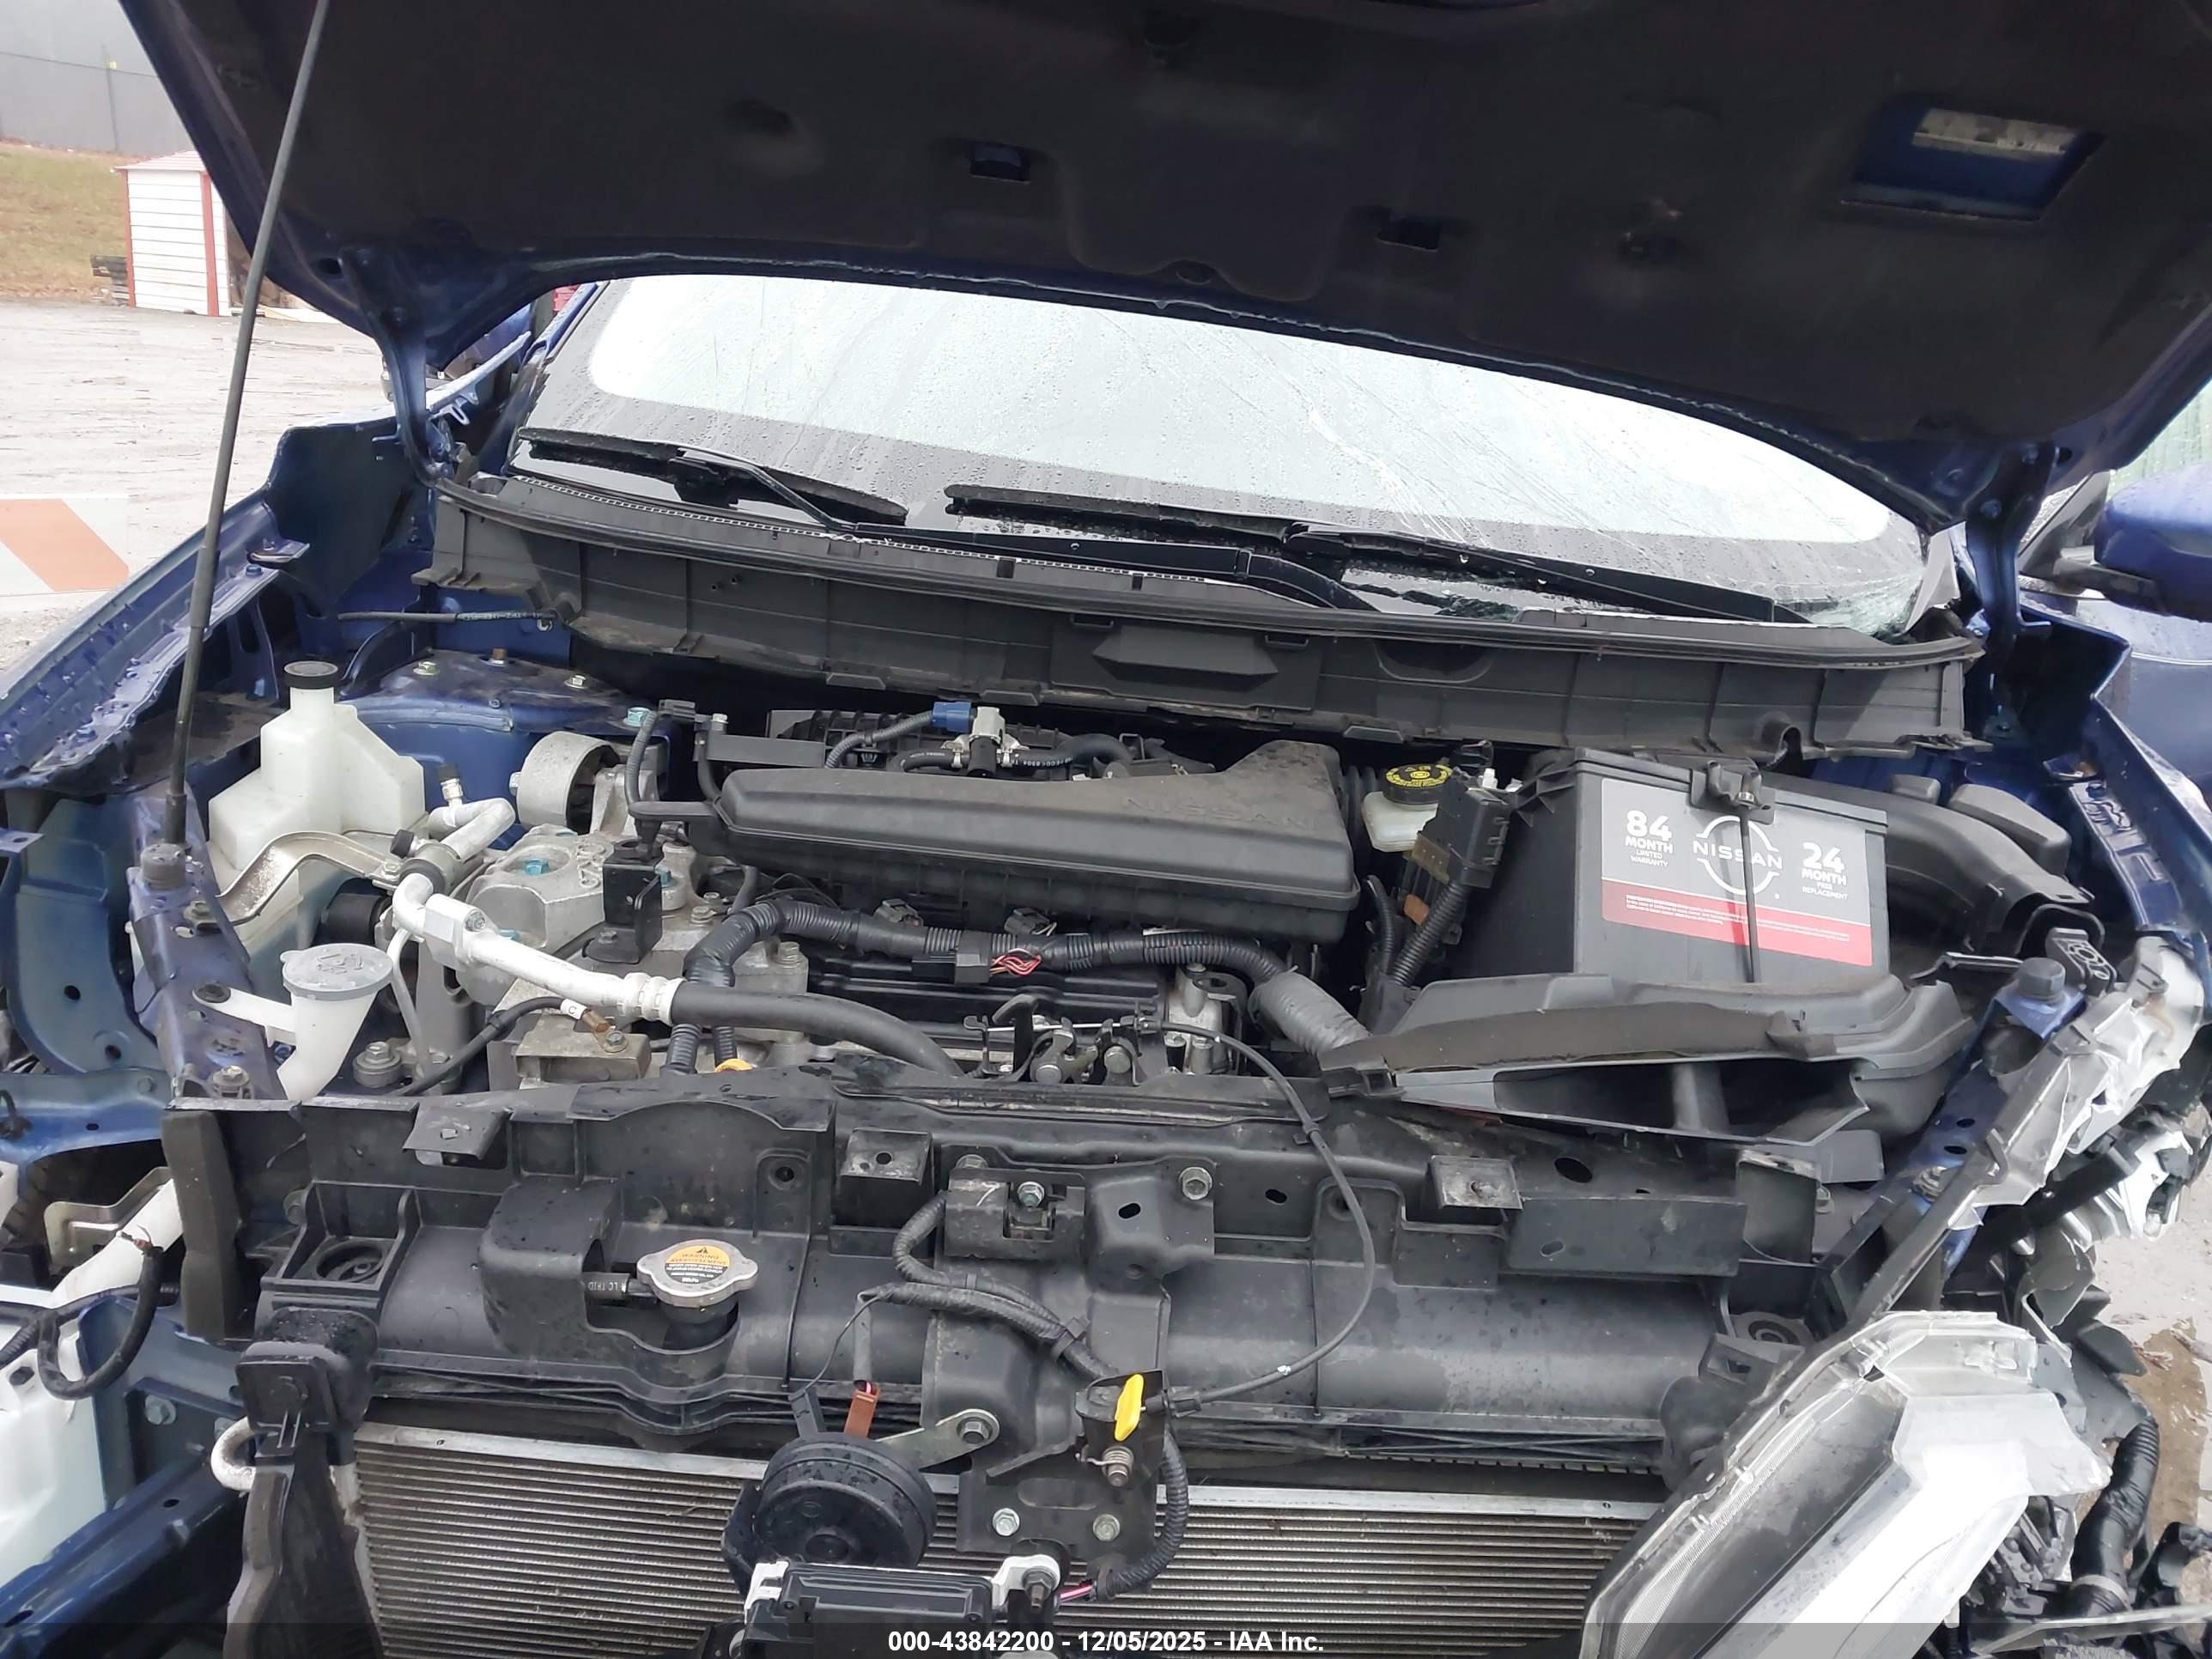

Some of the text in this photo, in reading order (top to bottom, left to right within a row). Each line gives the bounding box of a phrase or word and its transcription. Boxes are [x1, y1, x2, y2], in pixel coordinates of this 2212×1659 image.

[1123, 798, 1316, 831] NISSAN
[1626, 810, 1673, 842] 84
[1625, 835, 1674, 854] MONTH
[1636, 848, 1662, 860] LIMITED
[1630, 854, 1668, 866] WARRANTY
[1692, 840, 1783, 870] NISSAN
[1802, 842, 1845, 873] 24
[1802, 867, 1847, 886] MONTH
[1802, 885, 1848, 901] REPLACEMENT
[568, 1006, 577, 1015] C
